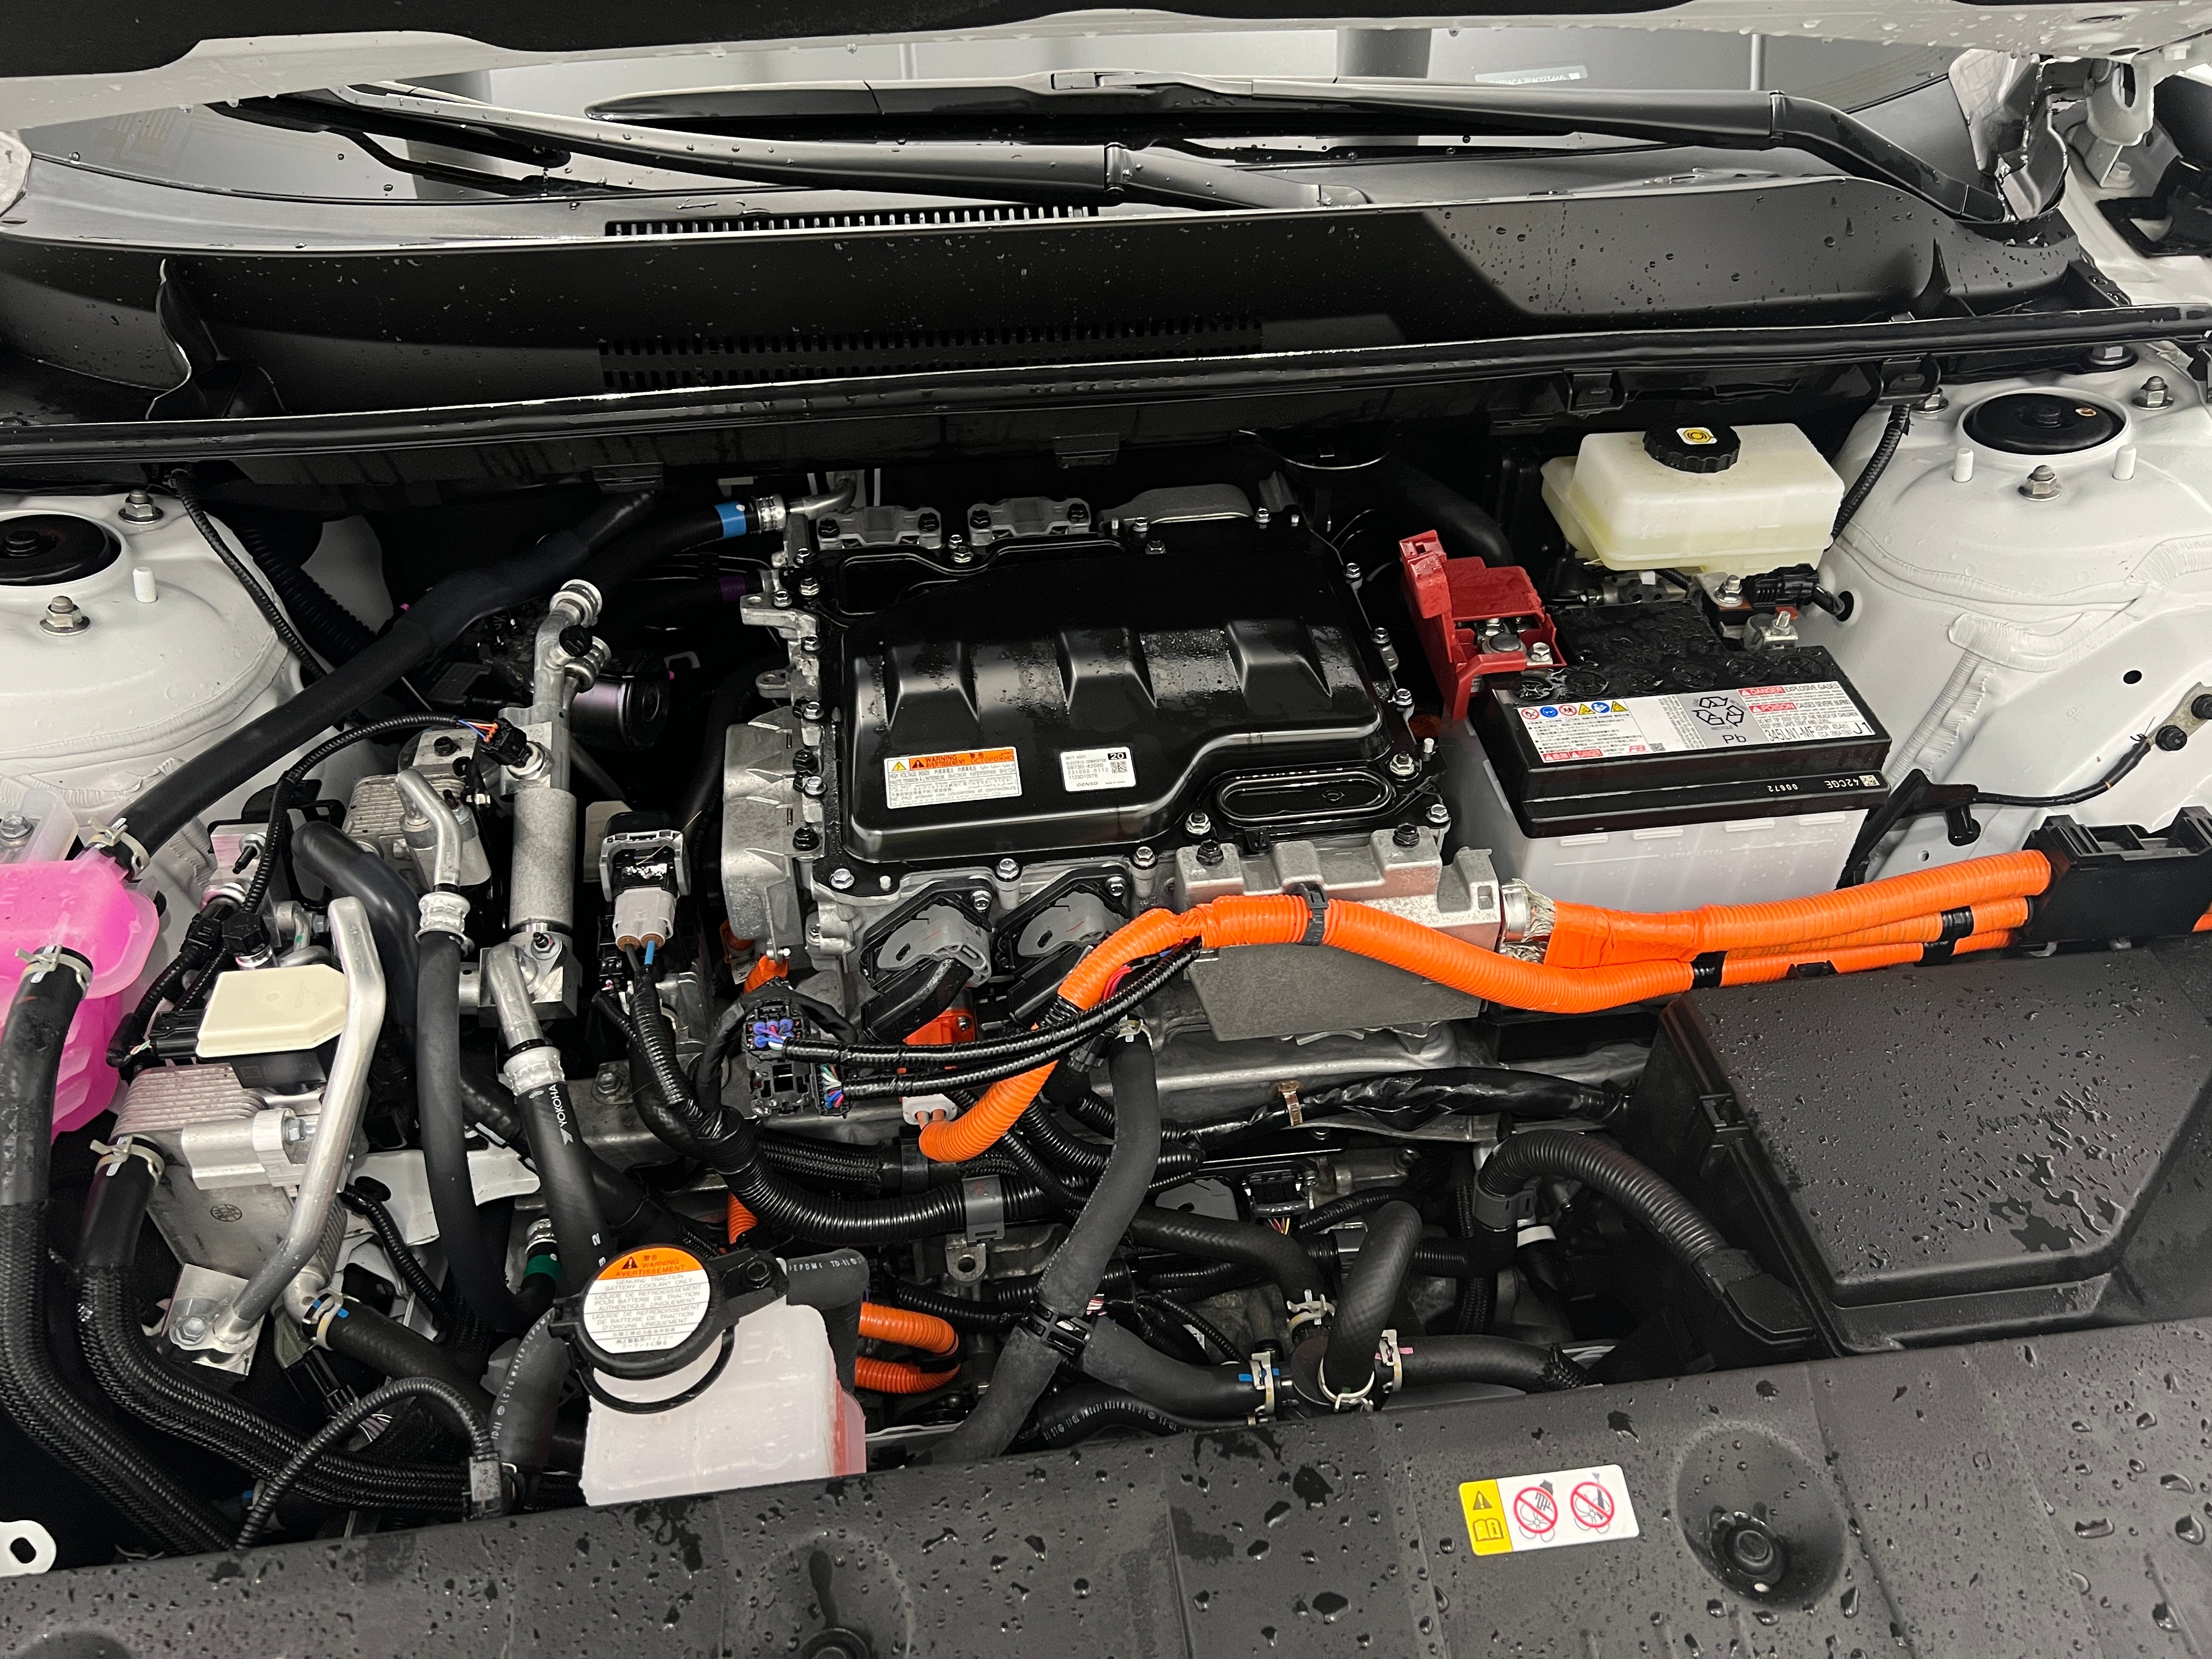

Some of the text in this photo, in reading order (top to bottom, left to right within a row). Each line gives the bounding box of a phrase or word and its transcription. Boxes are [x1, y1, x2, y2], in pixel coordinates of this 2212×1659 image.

[1723, 734, 1746, 743] Pb
[1765, 726, 1815, 741] 345LN1-MF
[926, 754, 957, 763] WARNING
[926, 759, 966, 769] AVERTISSEMENT
[1824, 778, 1859, 788] 42CGE
[642, 1259, 679, 1268] WARNING
[616, 1265, 685, 1277] AVERTISSEMENT
[639, 1284, 701, 1296] REFROIDISSEMENT
[667, 1291, 699, 1299] TRACTION
[599, 1298, 695, 1311] AUTHENTIQUE UNIQUEMENT
[636, 1304, 699, 1316] REFROIDISSEMENT
[642, 1318, 686, 1327] UNIQUEMENT
[1105, 1401, 1125, 1409] WATER
